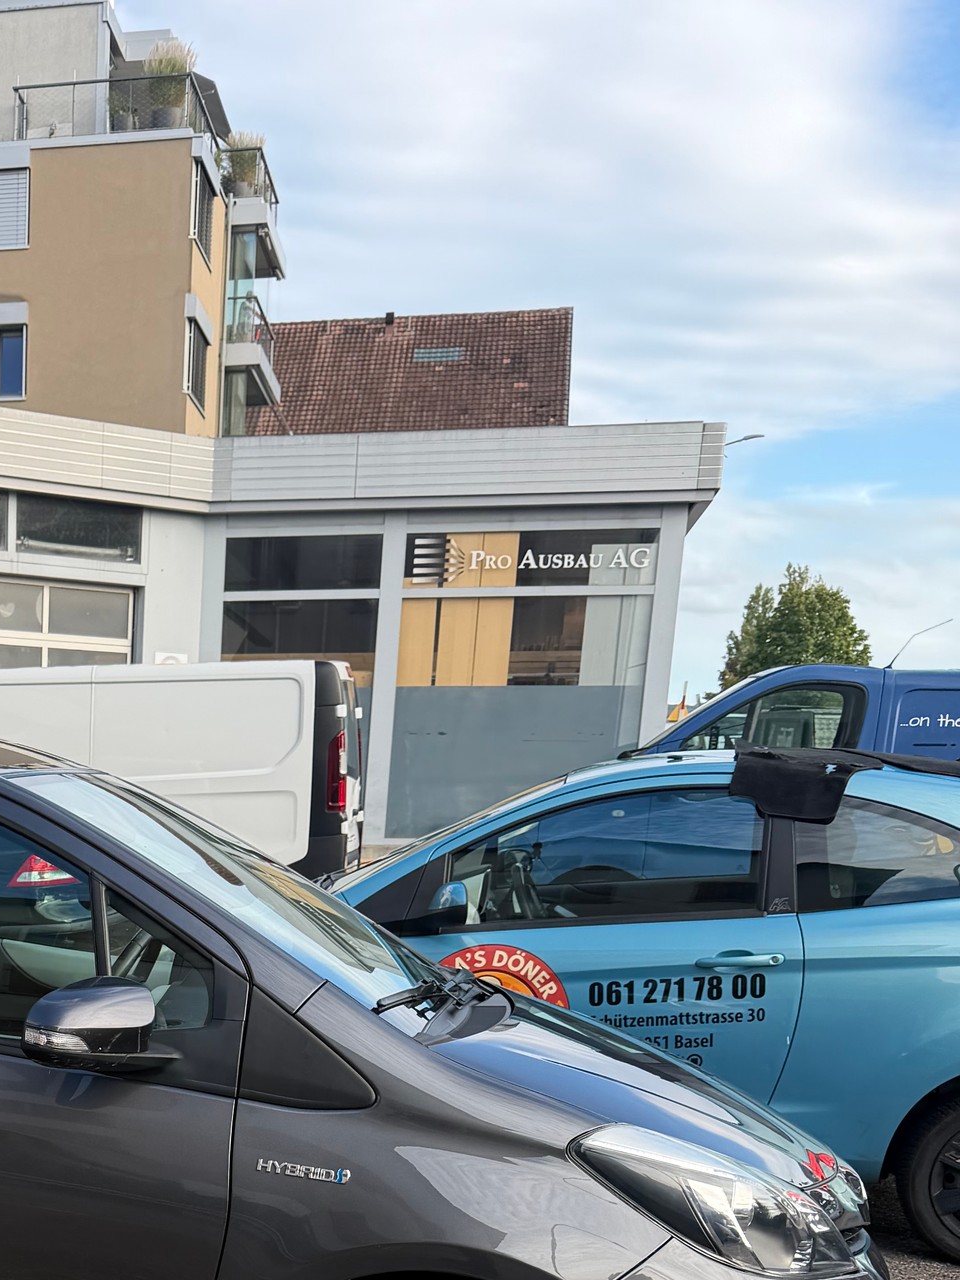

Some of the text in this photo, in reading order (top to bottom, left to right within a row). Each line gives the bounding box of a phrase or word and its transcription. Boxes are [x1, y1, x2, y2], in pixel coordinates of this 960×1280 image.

[609, 547, 651, 568] AG
[449, 950, 558, 1000] A'S DÖNER
[588, 973, 766, 1006] 061 271 78 00
[591, 1008, 765, 1029] hützenmattstrasse 30
[674, 1033, 714, 1049] Basel
[256, 1158, 335, 1182] HYBRID
